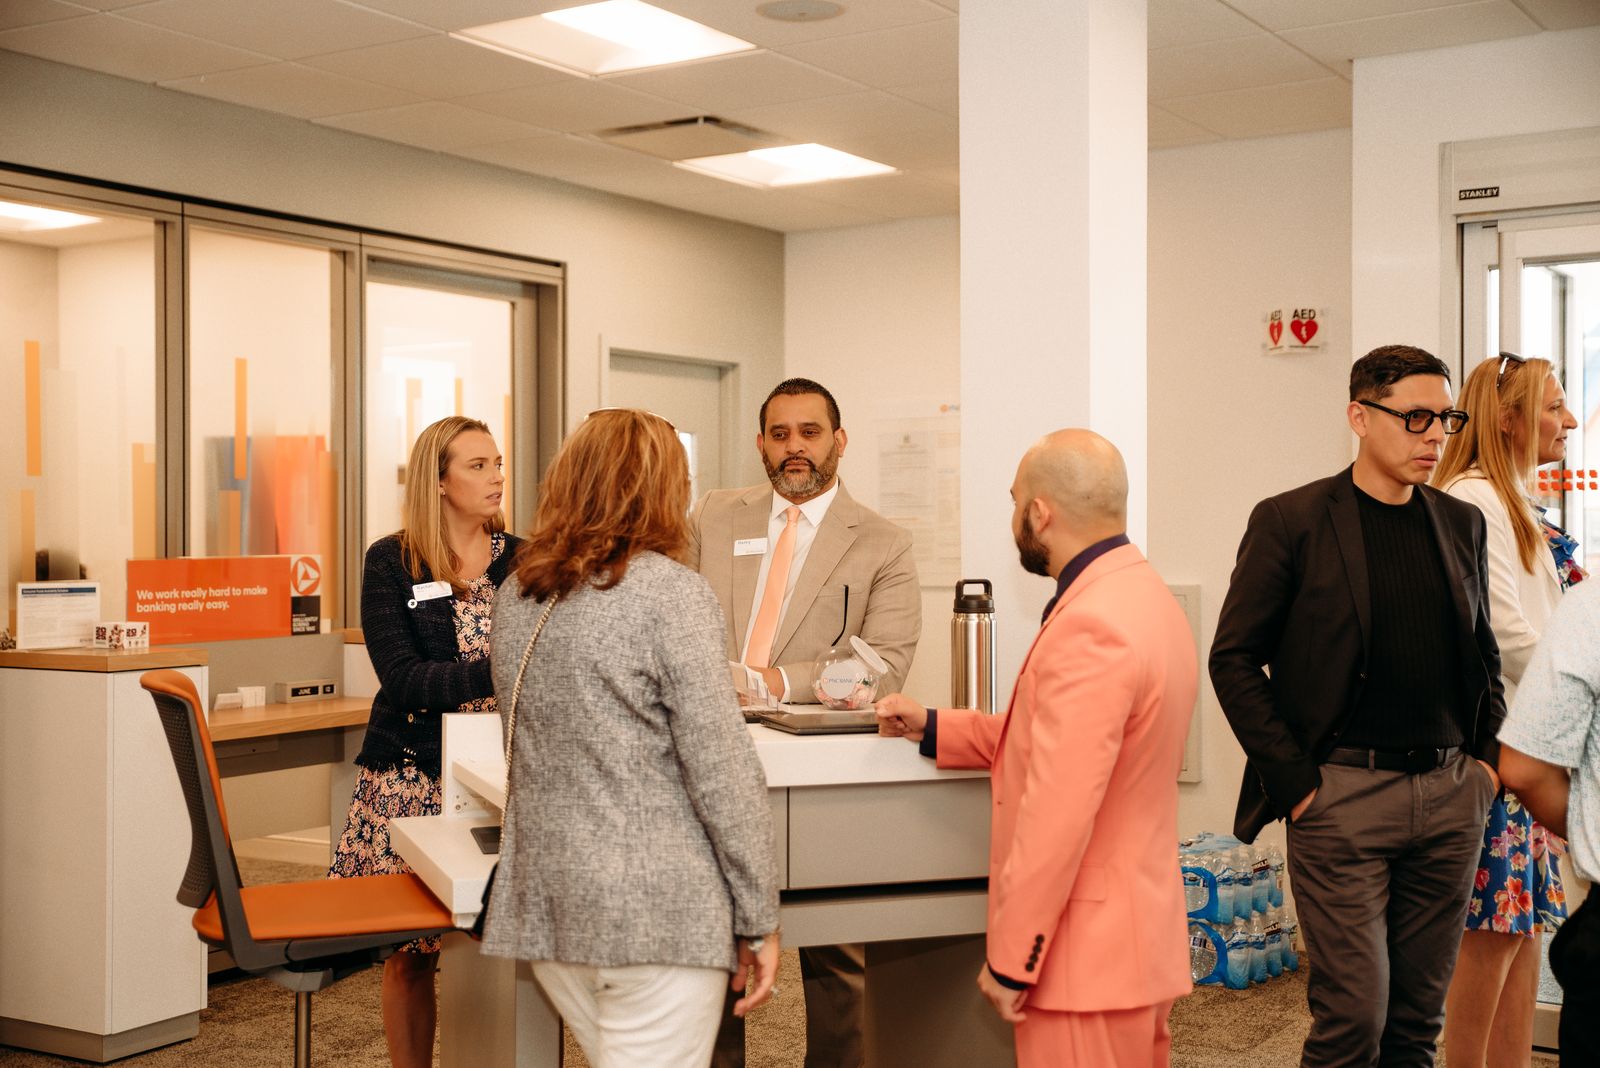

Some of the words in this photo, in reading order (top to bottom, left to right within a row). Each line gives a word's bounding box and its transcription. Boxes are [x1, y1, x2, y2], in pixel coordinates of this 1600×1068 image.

[1460, 189, 1498, 199] STANLEY
[1293, 308, 1316, 320] AED
[136, 590, 153, 600] We
[155, 589, 179, 599] work
[181, 587, 207, 599] really
[208, 587, 231, 597] hard
[232, 588, 241, 596] to
[243, 586, 268, 595] make
[136, 601, 176, 613] banking
[178, 600, 205, 611] really
[206, 601, 230, 610] easy.
